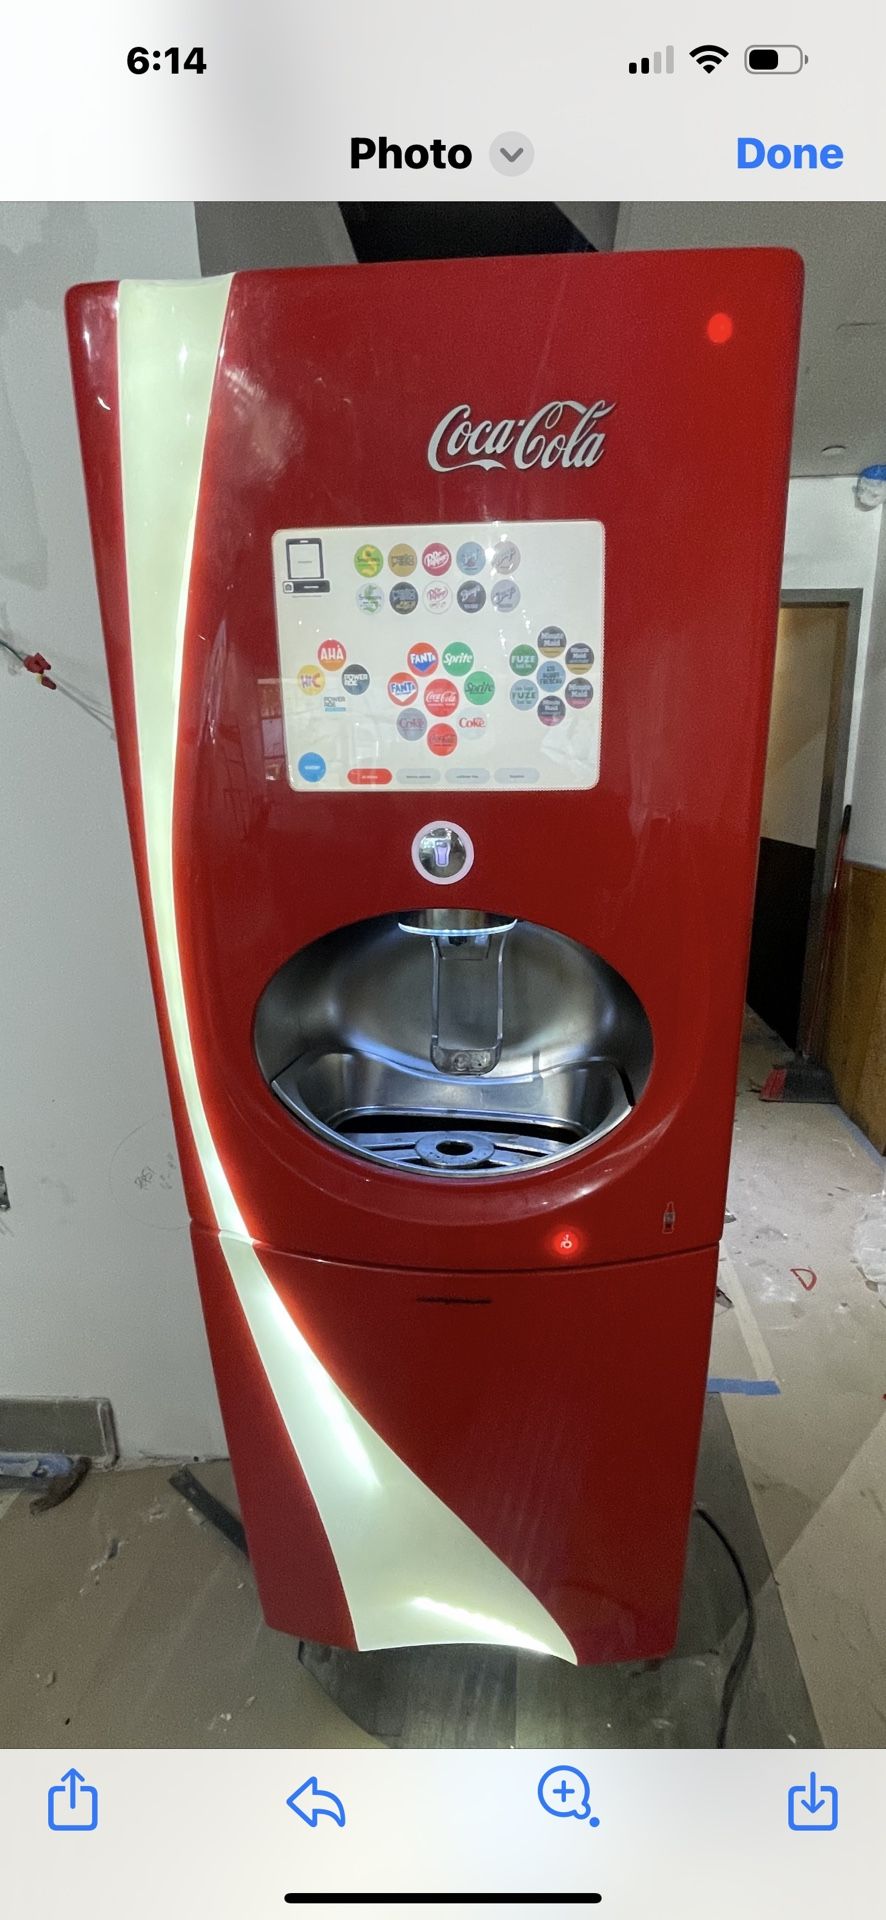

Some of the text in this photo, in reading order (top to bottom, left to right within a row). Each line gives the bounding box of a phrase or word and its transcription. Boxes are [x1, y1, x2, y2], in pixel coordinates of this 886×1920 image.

[428, 400, 616, 472] Coca-Cola
[410, 652, 437, 664] FANTA
[443, 653, 473, 666] Sprite
[511, 655, 536, 663] FUZE
[464, 682, 494, 694] Sprite
[511, 691, 537, 699] FUZE
[458, 717, 486, 728] Coke
